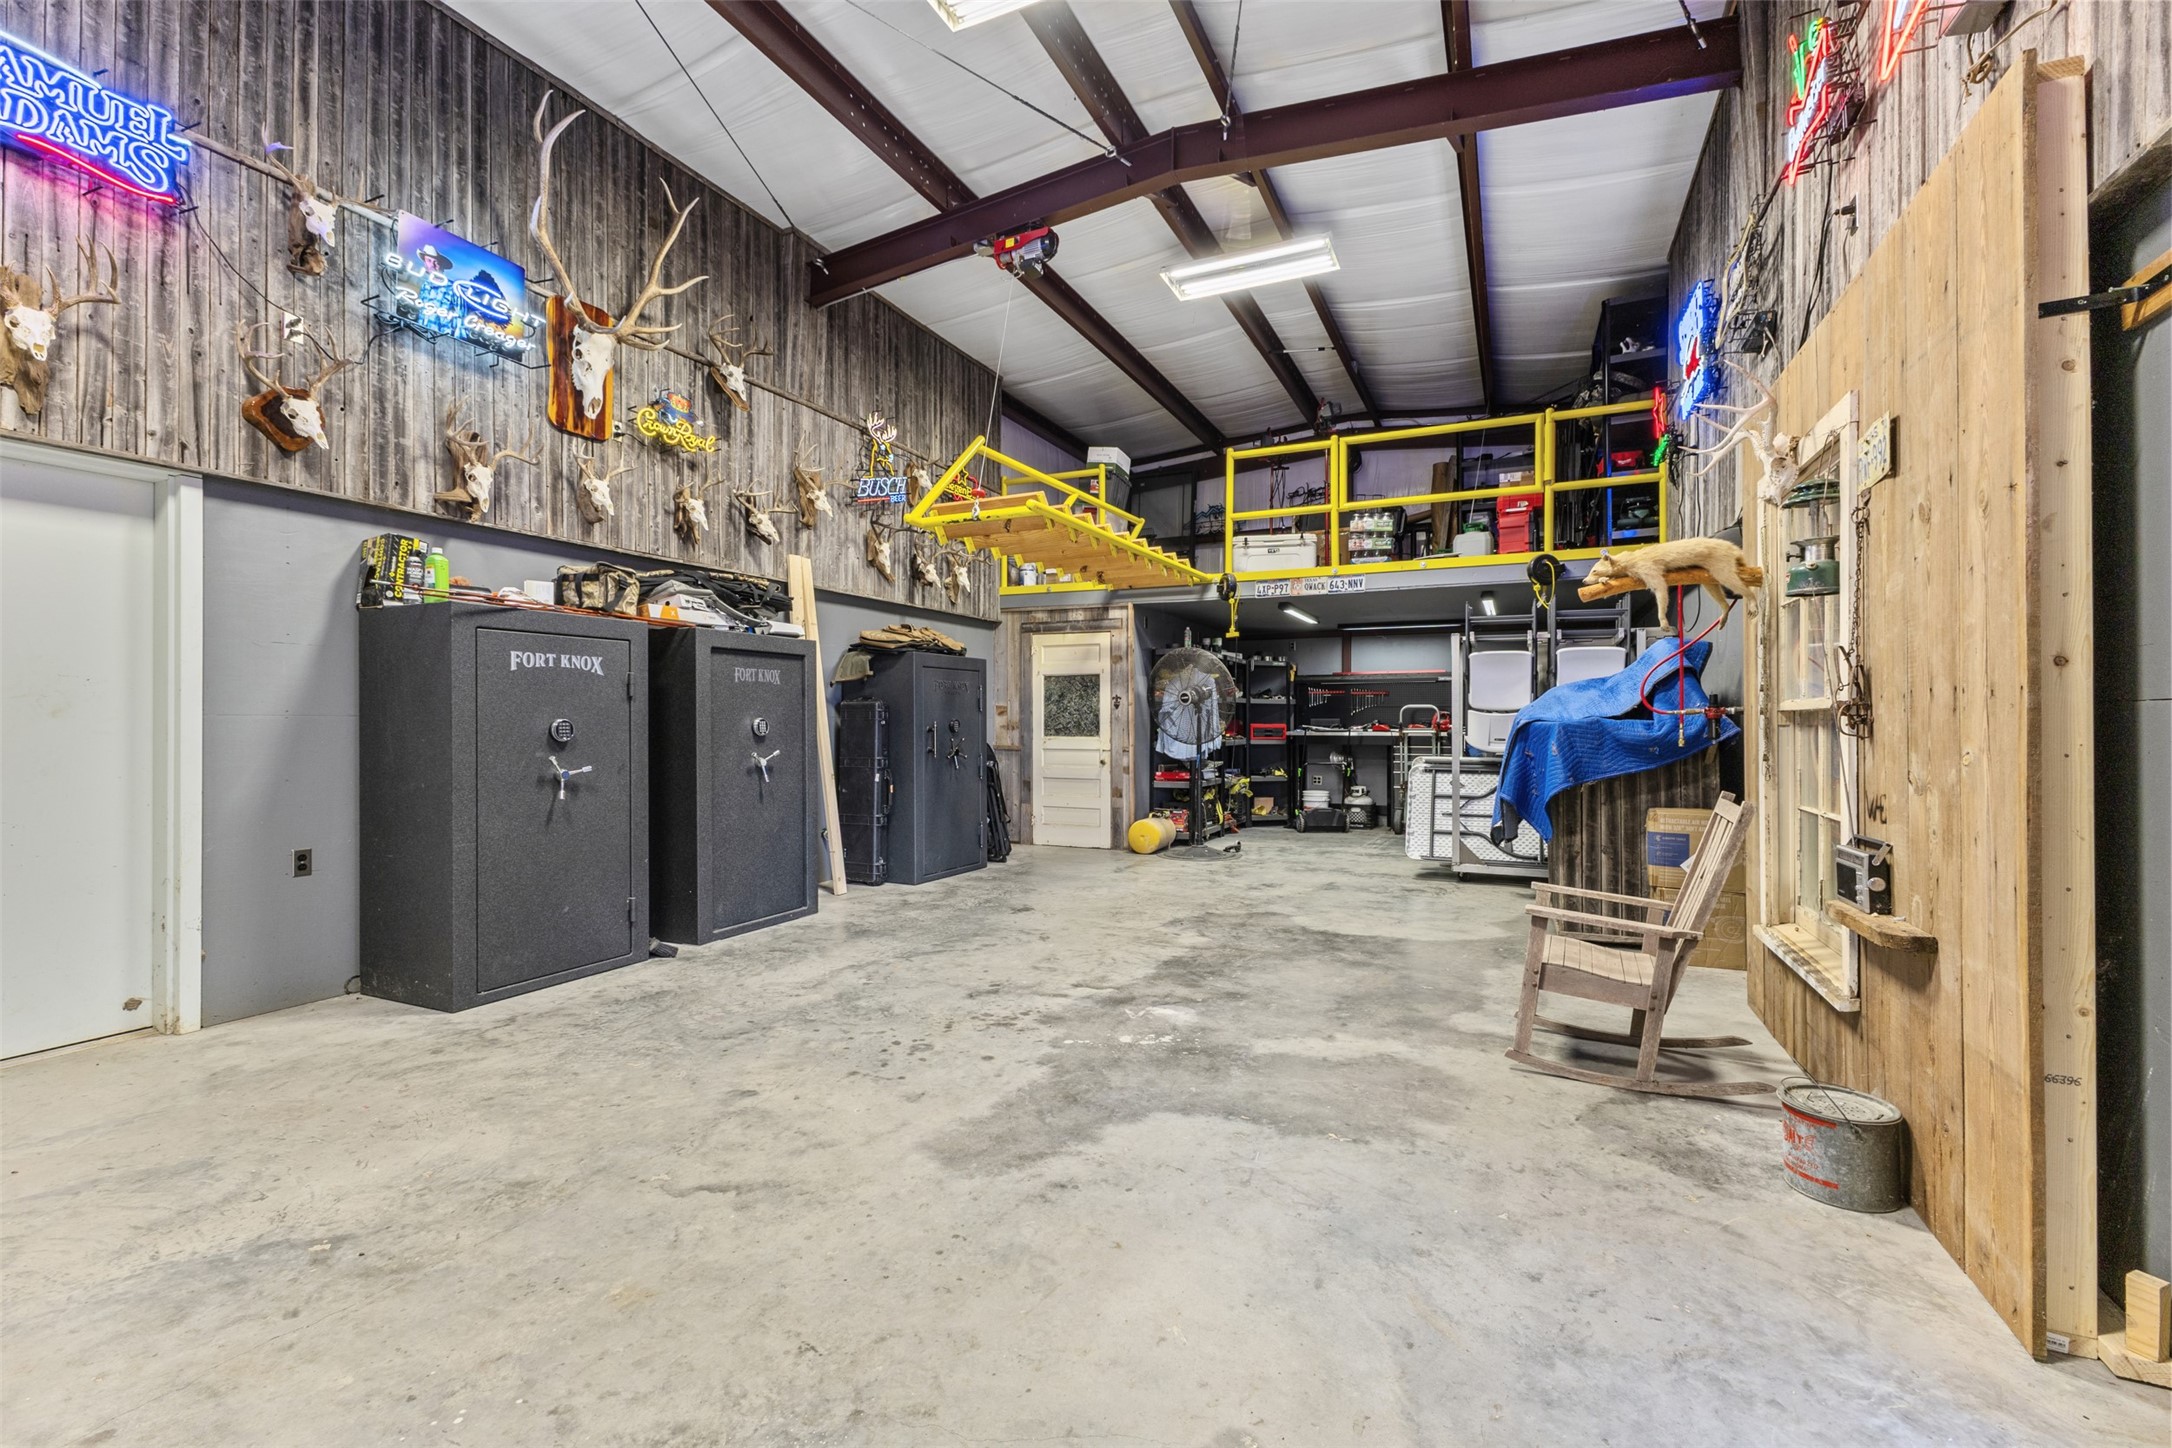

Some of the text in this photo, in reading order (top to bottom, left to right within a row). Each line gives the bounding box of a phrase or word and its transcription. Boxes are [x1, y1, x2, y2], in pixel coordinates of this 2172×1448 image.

[385, 251, 547, 327] BUD LIGHT
[395, 284, 537, 351] Roger Creager
[637, 407, 718, 452] Crown Royal
[857, 476, 908, 497] BUSCH
[890, 495, 907, 503] BEER
[394, 538, 409, 598] CONTRACTOR
[510, 650, 605, 676] FORT KNOX
[734, 667, 781, 685] FORT KNOX
